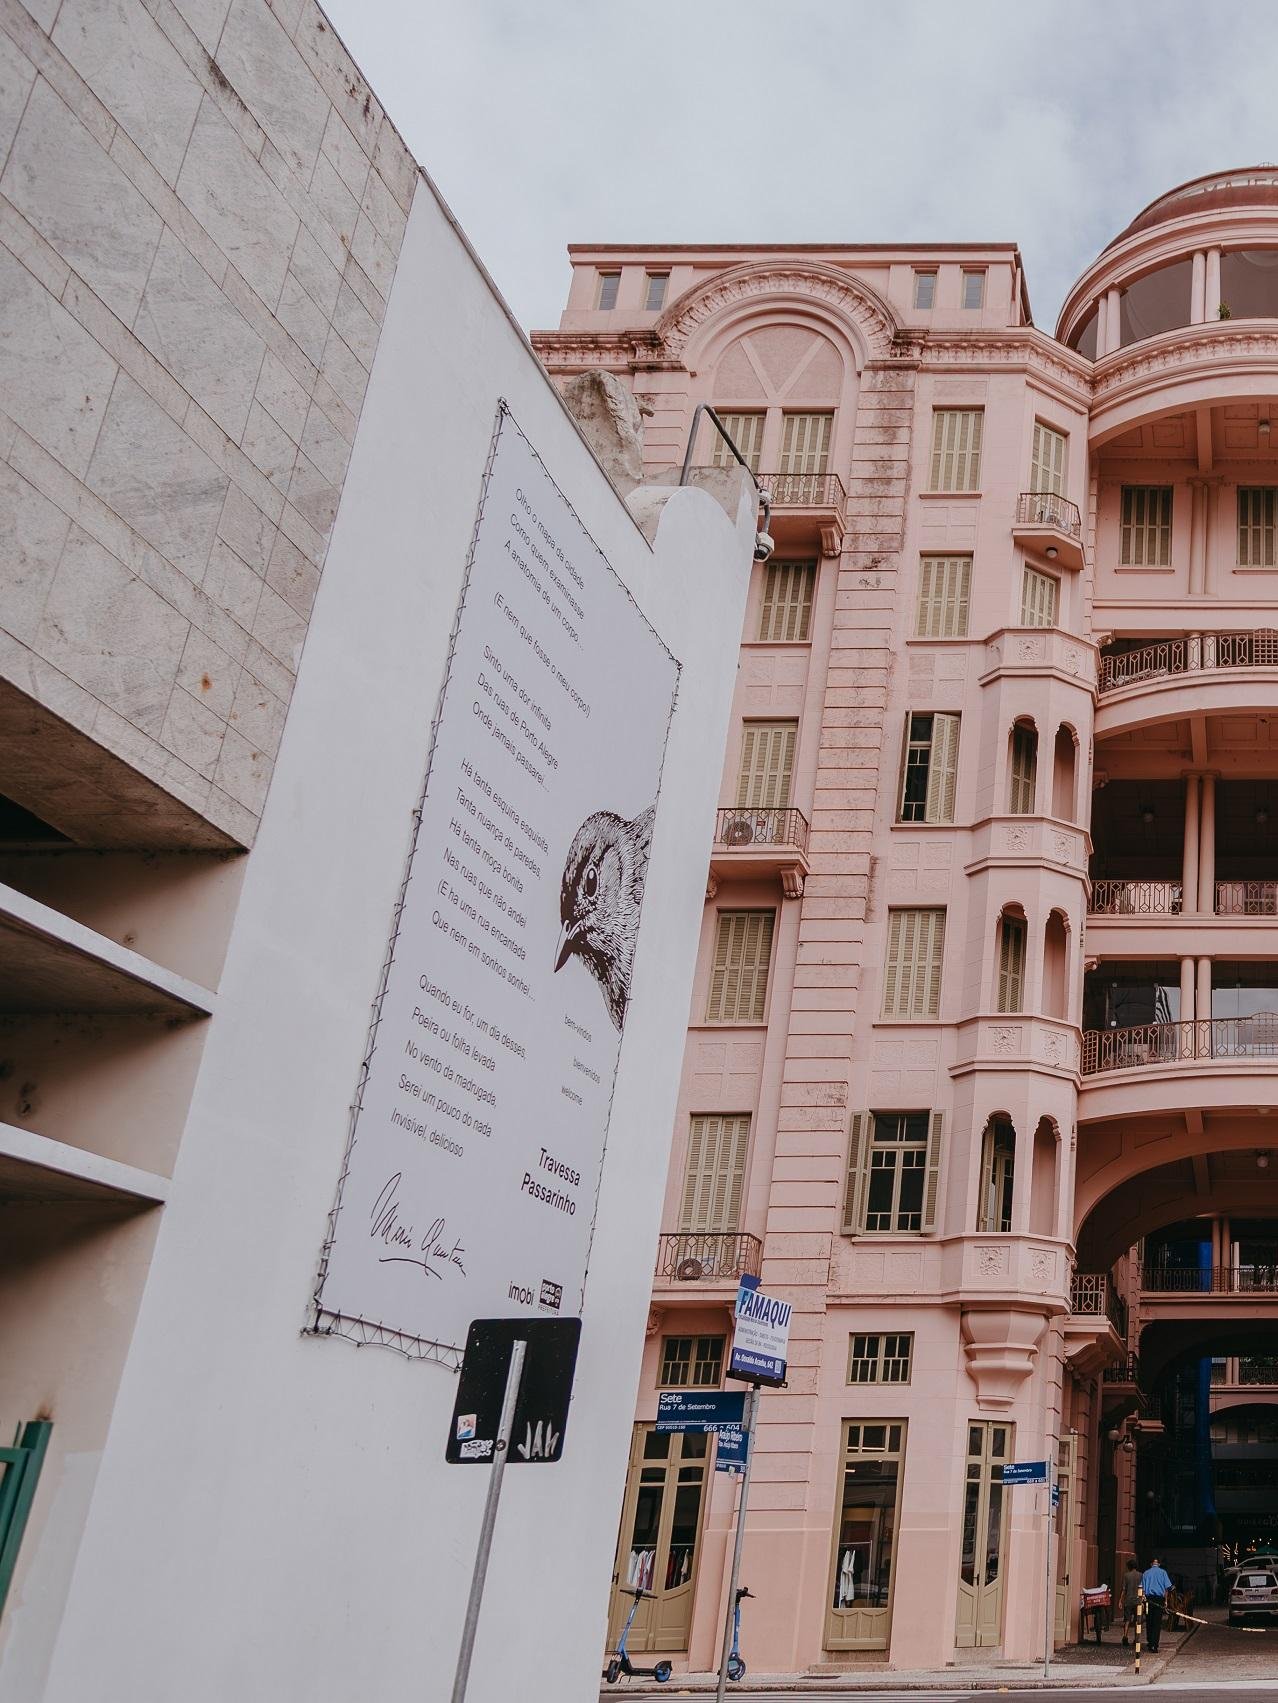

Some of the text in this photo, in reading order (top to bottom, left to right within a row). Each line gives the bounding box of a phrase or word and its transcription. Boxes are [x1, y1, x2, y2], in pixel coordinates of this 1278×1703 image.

[510, 514, 584, 620] Como quem examinasse
[516, 489, 584, 590] Olho o mapa da cidade
[504, 540, 510, 552] A
[511, 550, 542, 592] anatomia
[542, 590, 550, 604] de
[550, 602, 562, 619] um
[494, 592, 504, 608] (E
[504, 606, 520, 628] nem
[520, 626, 532, 644] que
[533, 640, 550, 667] fosse
[551, 664, 556, 674] o
[556, 672, 570, 690] meu
[478, 672, 558, 770] Das ruas de Porto Alegre
[484, 645, 552, 730] Sinto uma dor infinita
[472, 701, 492, 730] Onde
[492, 722, 516, 756] jamais
[456, 786, 476, 816] Tanta
[477, 812, 504, 842] nuança
[504, 836, 514, 851] de
[460, 758, 473, 777] Há
[473, 770, 492, 796] tanta
[492, 793, 520, 824] esquina
[444, 847, 528, 928] Nas ruas que não andei
[448, 816, 524, 893] Há tanta moça bonita
[432, 910, 449, 932] Que
[450, 927, 468, 948] nem
[468, 942, 480, 958] em
[480, 952, 508, 978] sonhos
[438, 878, 449, 896] (E
[460, 902, 477, 920] uma
[478, 915, 490, 931] rua
[490, 926, 526, 960] encantada
[411, 1006, 496, 1072] Poeira ou folha levada
[419, 974, 450, 1006] Quando
[452, 1000, 462, 1015] eu
[462, 1004, 474, 1026] for,
[476, 1016, 488, 1034] um
[489, 1025, 501, 1041] dia
[398, 1073, 492, 1138] Serei um pouco do nada
[405, 1040, 497, 1108] No vento da madrugada,
[390, 1107, 464, 1158] Invisível, delicioso
[520, 1172, 576, 1216] Passarinho
[538, 1148, 581, 1186] Travessa
[508, 1280, 535, 1306] imobi
[738, 1290, 792, 1329] FAMAQUI
[660, 1394, 682, 1403] Sete
